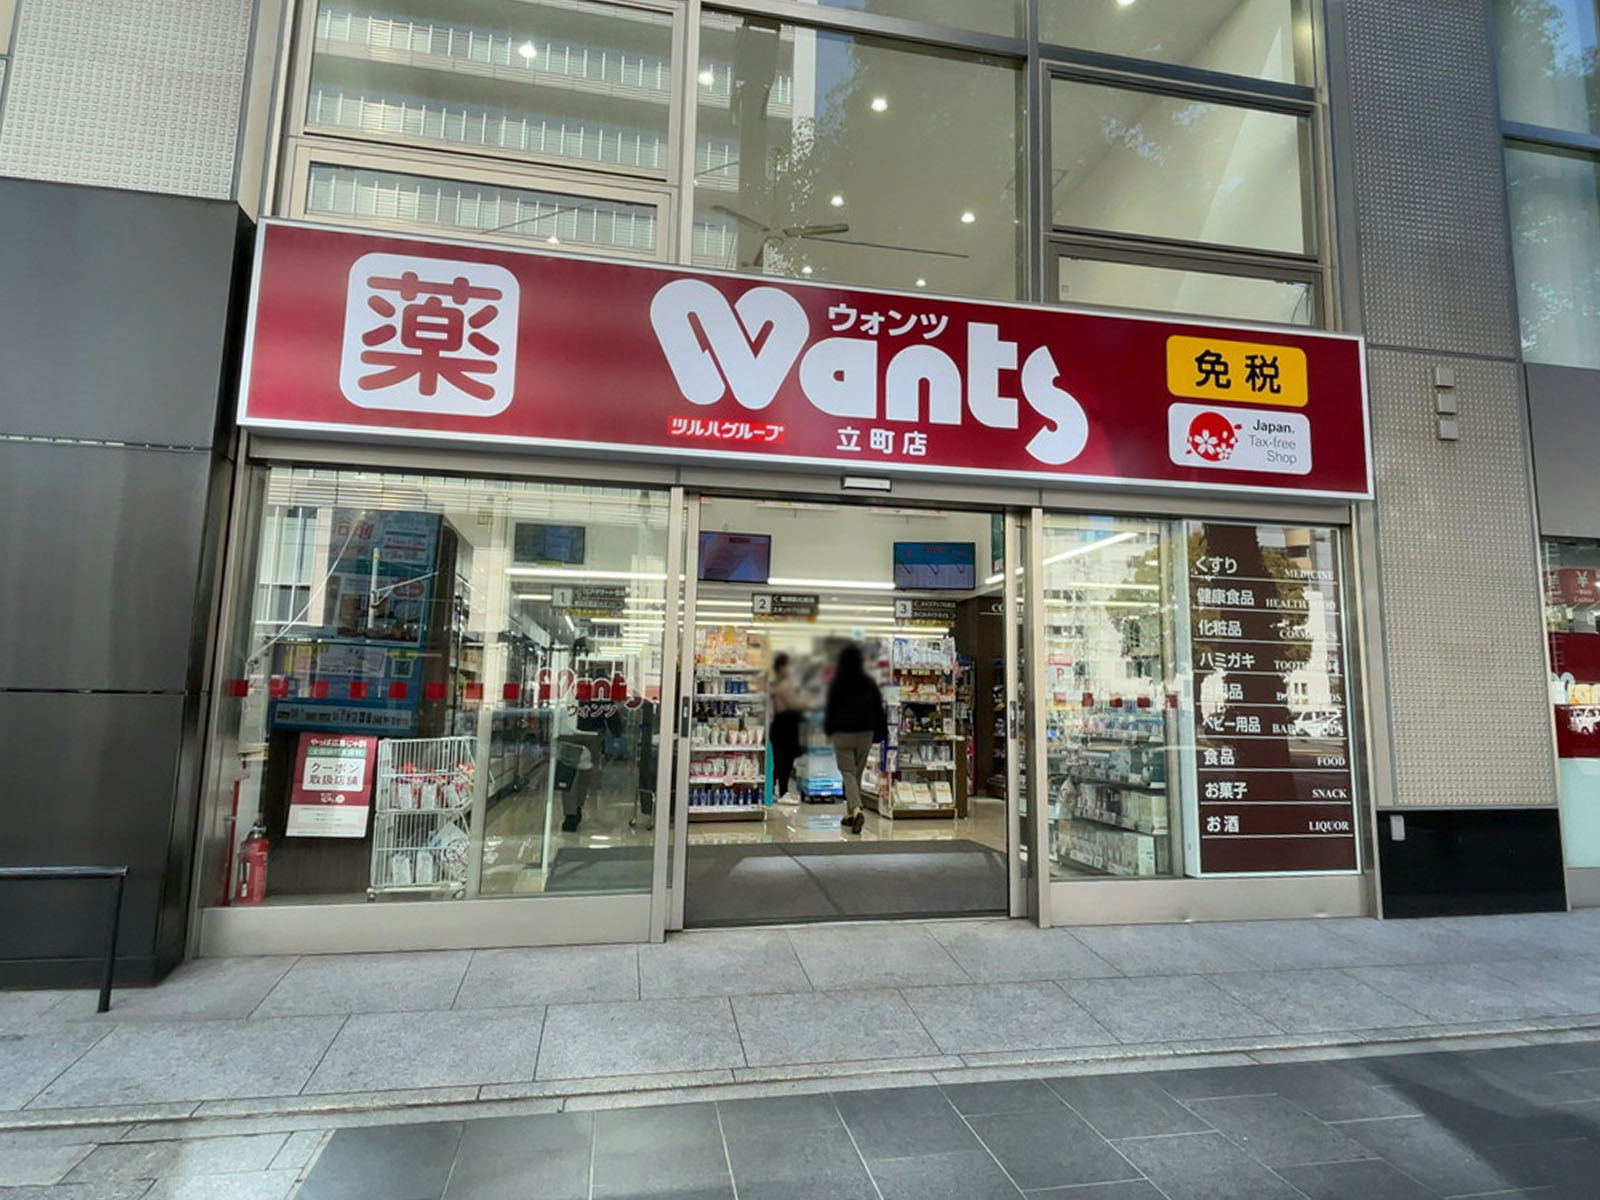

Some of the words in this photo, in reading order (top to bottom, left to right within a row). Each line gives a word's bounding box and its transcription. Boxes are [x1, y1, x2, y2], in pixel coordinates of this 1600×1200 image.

[828, 303, 949, 340] ウォンツ
[357, 271, 503, 400] 薬
[650, 278, 1089, 465] Wants
[1195, 349, 1282, 395] 免税
[671, 417, 785, 442] ツルハグループ
[1252, 419, 1296, 434] Japan.
[836, 427, 929, 457] 立町店
[1249, 434, 1297, 451] Tax-free
[1266, 450, 1297, 466] Shop
[1195, 556, 1238, 573] くすり
[758, 597, 767, 610] 2
[1196, 587, 1256, 606] 健康食品
[899, 603, 908, 614] 3
[1198, 620, 1243, 638] 化粧品
[1199, 652, 1256, 669] ハミガキ
[1203, 748, 1236, 766] 食品
[1316, 756, 1346, 767] FOOD
[1204, 781, 1248, 800] お菓子
[1312, 788, 1348, 799] SNACK
[1206, 815, 1240, 833] お酒
[1308, 820, 1350, 832] LIQUOR
